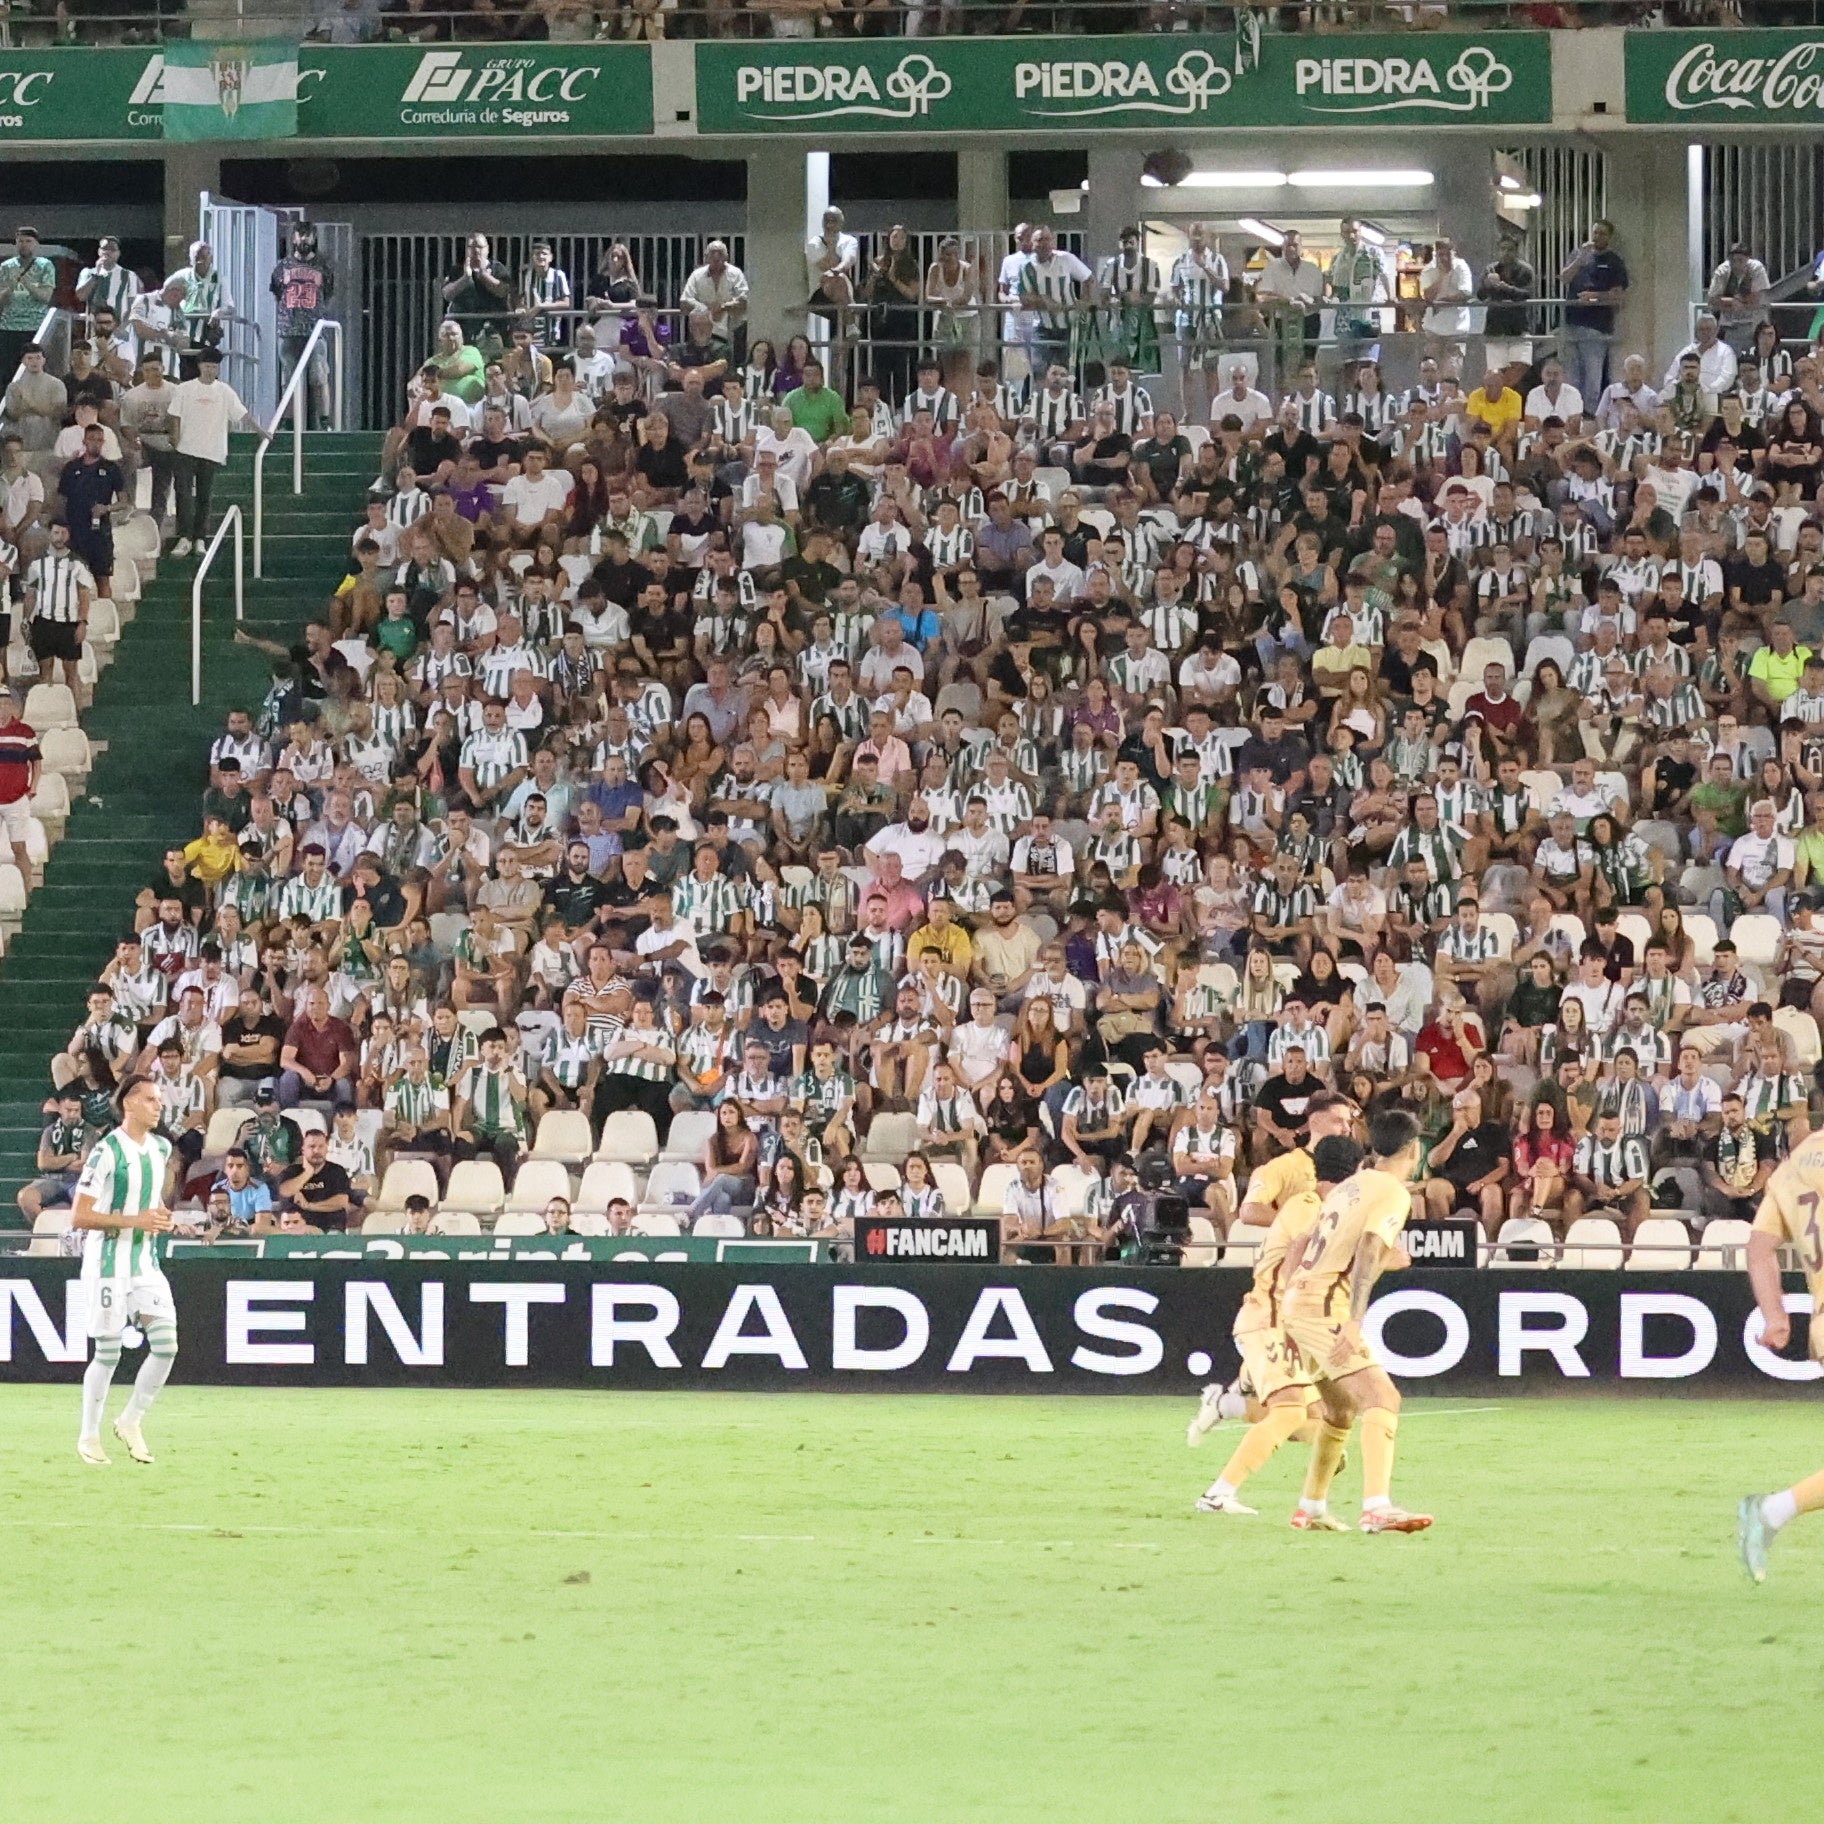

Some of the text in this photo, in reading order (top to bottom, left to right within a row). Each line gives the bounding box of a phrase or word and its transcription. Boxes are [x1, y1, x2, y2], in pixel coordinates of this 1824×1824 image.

[485, 58, 537, 69] GRUPO
[463, 66, 602, 103] PACC
[1665, 42, 1824, 110] Coca-Co
[479, 107, 499, 124] de
[502, 107, 570, 127] Seguros
[100, 1285, 113, 1309] 6
